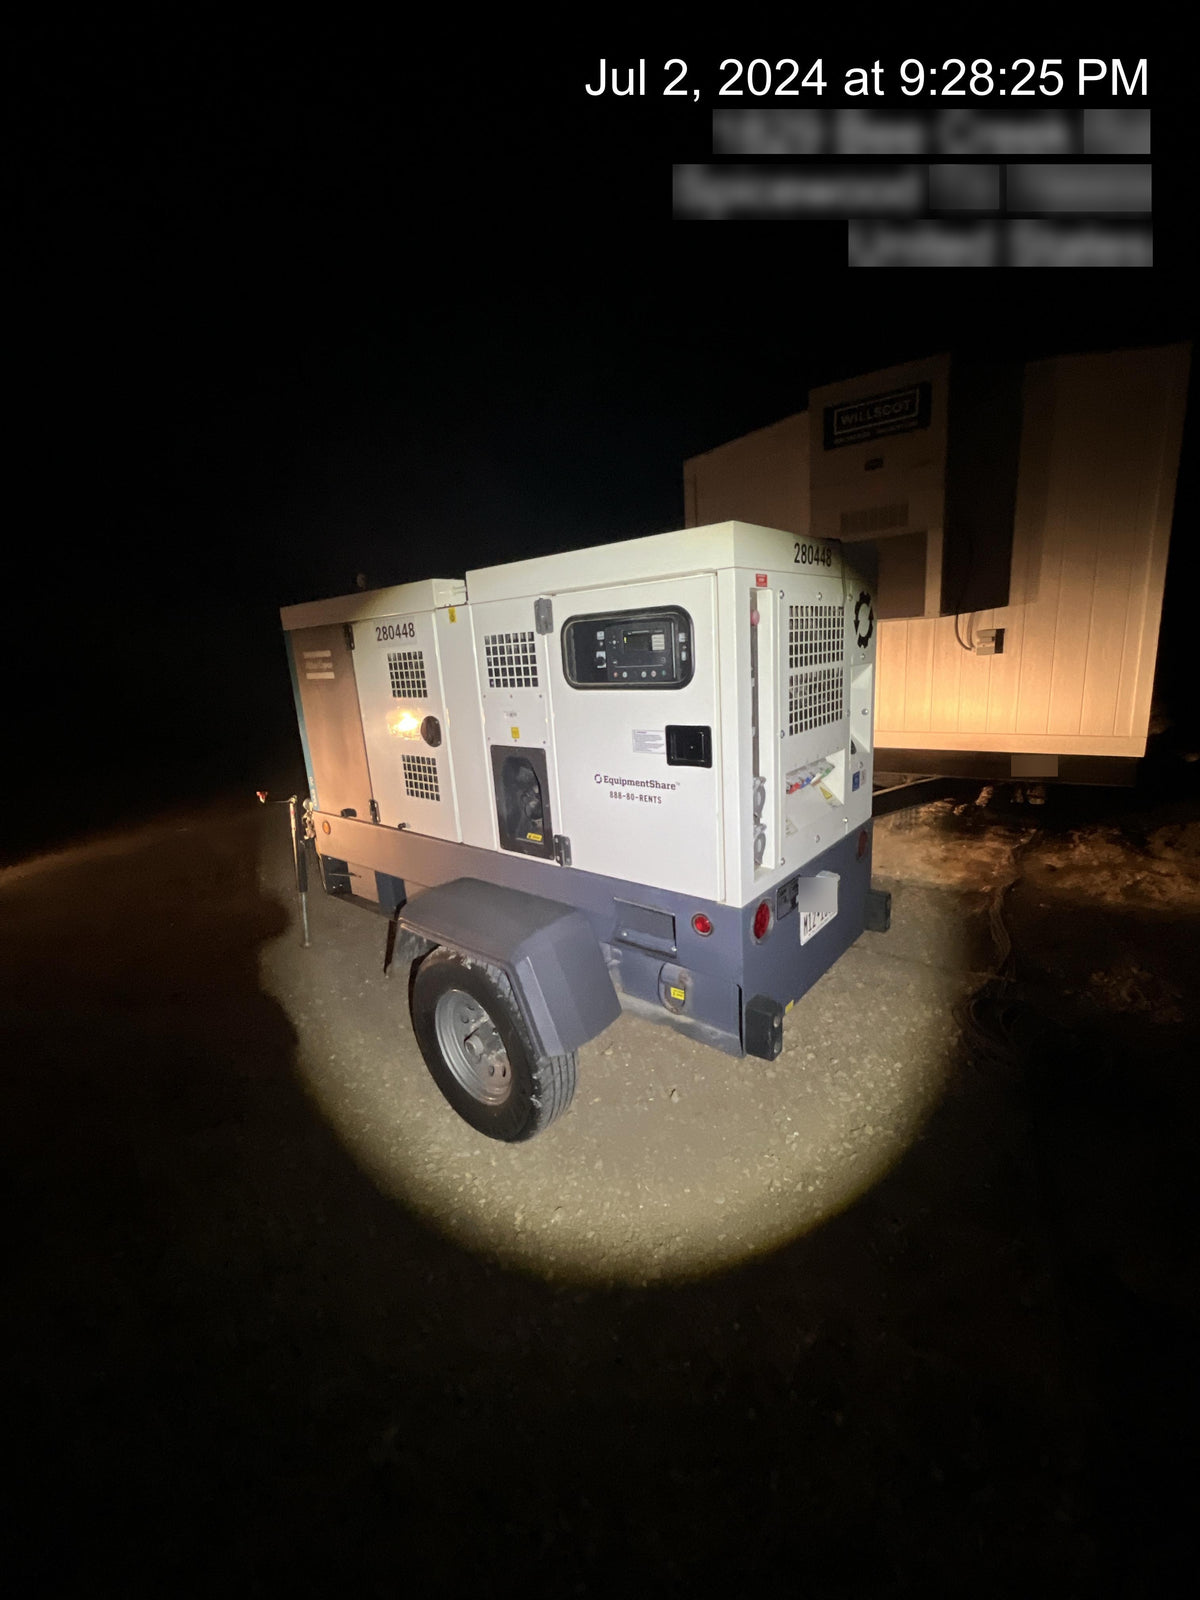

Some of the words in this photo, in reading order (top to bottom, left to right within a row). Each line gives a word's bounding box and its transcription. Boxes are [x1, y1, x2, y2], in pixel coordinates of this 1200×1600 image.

[840, 399, 911, 425] WILLSCOT
[793, 541, 832, 567] 280448
[375, 622, 415, 642] 280448
[609, 791, 662, 805] 888-80-RENTS
